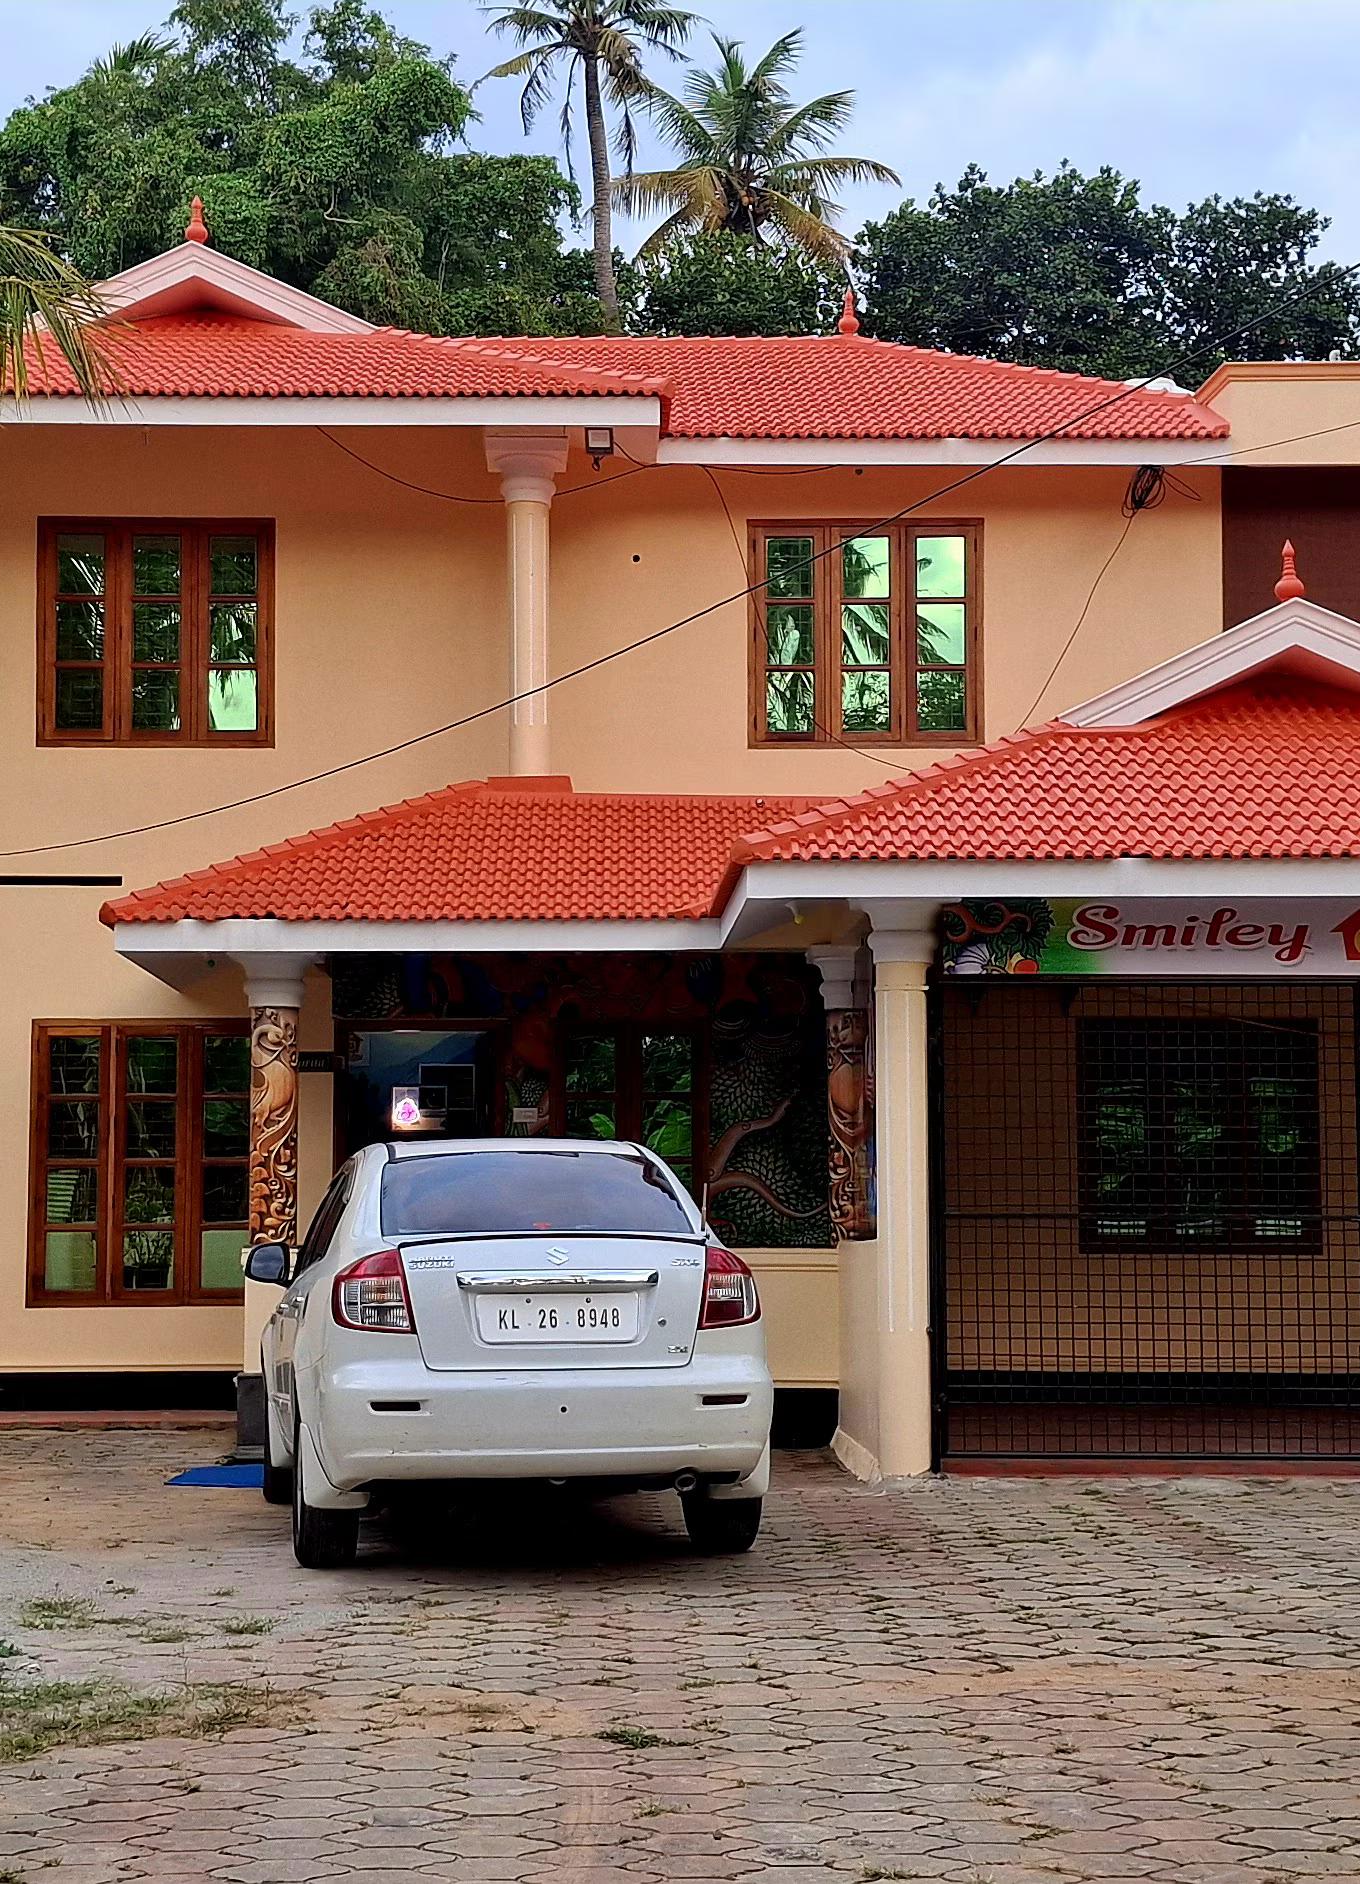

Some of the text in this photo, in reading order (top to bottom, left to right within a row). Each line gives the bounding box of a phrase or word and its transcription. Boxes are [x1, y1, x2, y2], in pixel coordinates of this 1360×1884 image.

[1067, 904, 1314, 964] Smiley
[408, 1260, 455, 1270] SUZUKI
[498, 1307, 620, 1330] KL 26 8948
